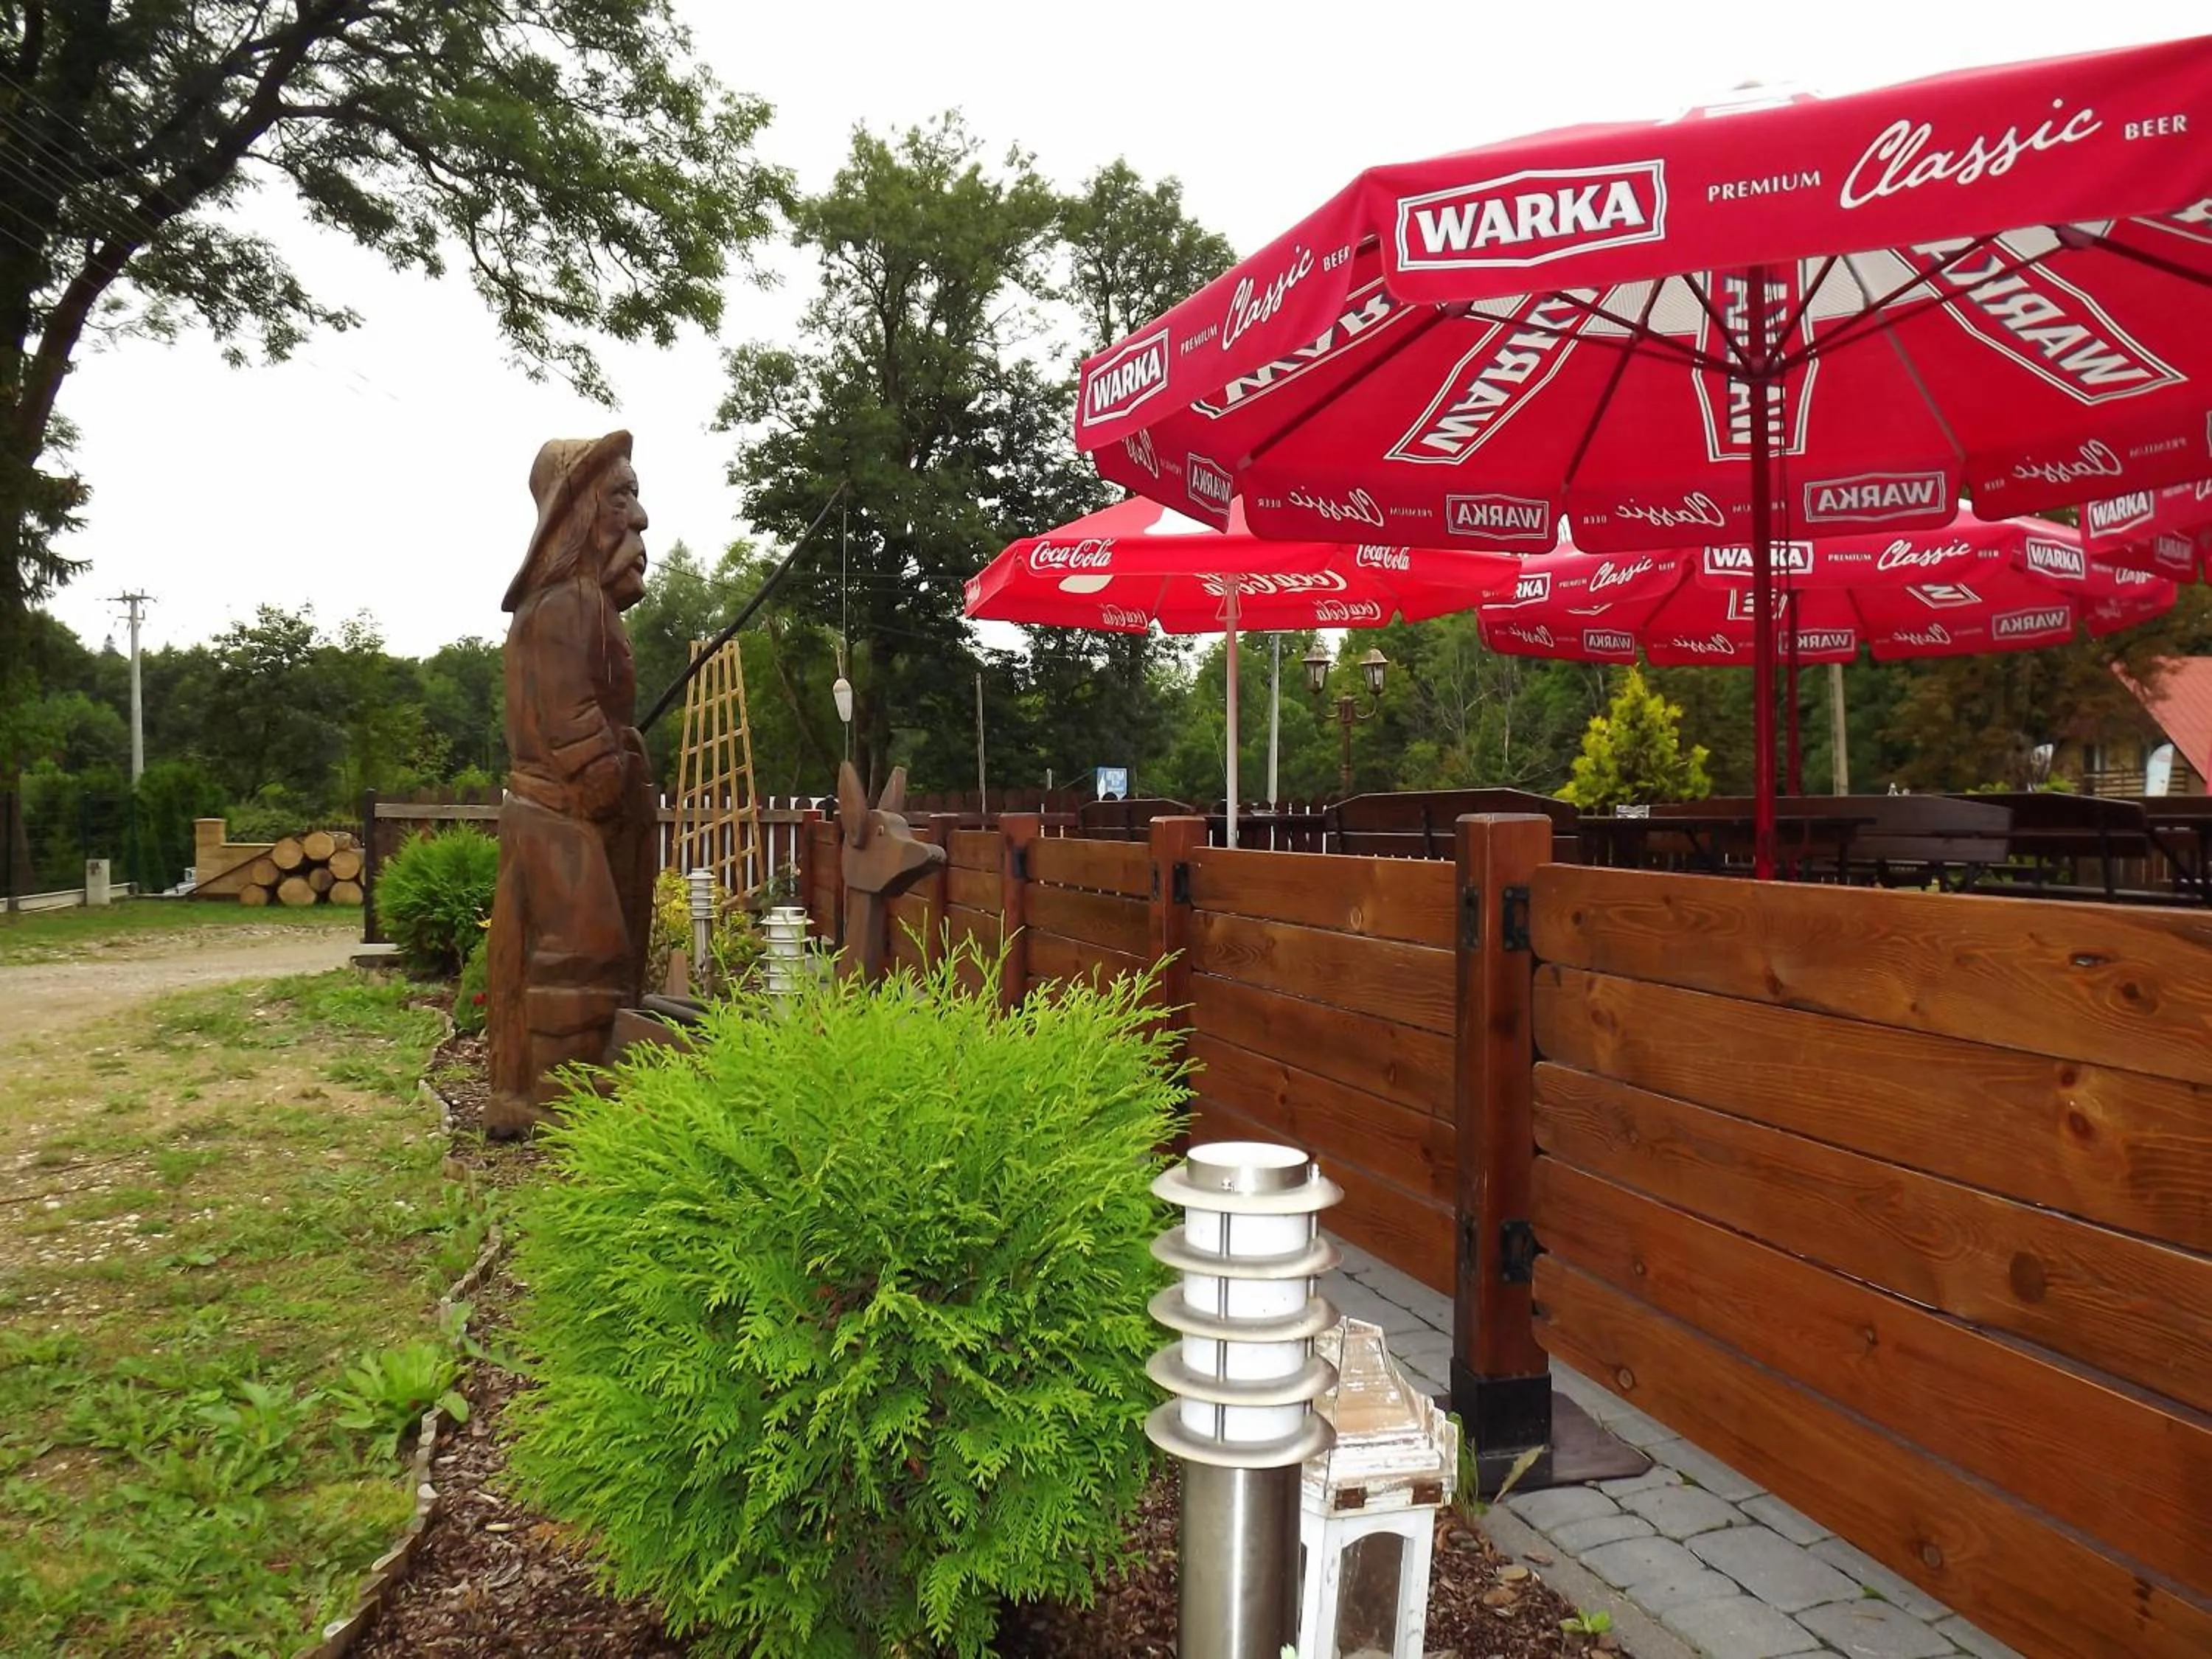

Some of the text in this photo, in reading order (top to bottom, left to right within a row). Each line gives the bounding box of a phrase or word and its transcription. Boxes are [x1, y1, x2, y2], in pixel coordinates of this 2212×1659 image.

[1415, 99, 2188, 253] WARKA PREMIUM Classic BEER
[1093, 346, 1162, 412] WARKA
[1180, 324, 1217, 356] PREMIUM
[1222, 245, 1315, 351] Classic
[2091, 491, 2149, 528] WARKA
[1711, 547, 1806, 568] WAKA
[1876, 538, 1972, 571] Classic
[2029, 543, 2081, 573] WARKA
[1590, 555, 1654, 593] Classic
